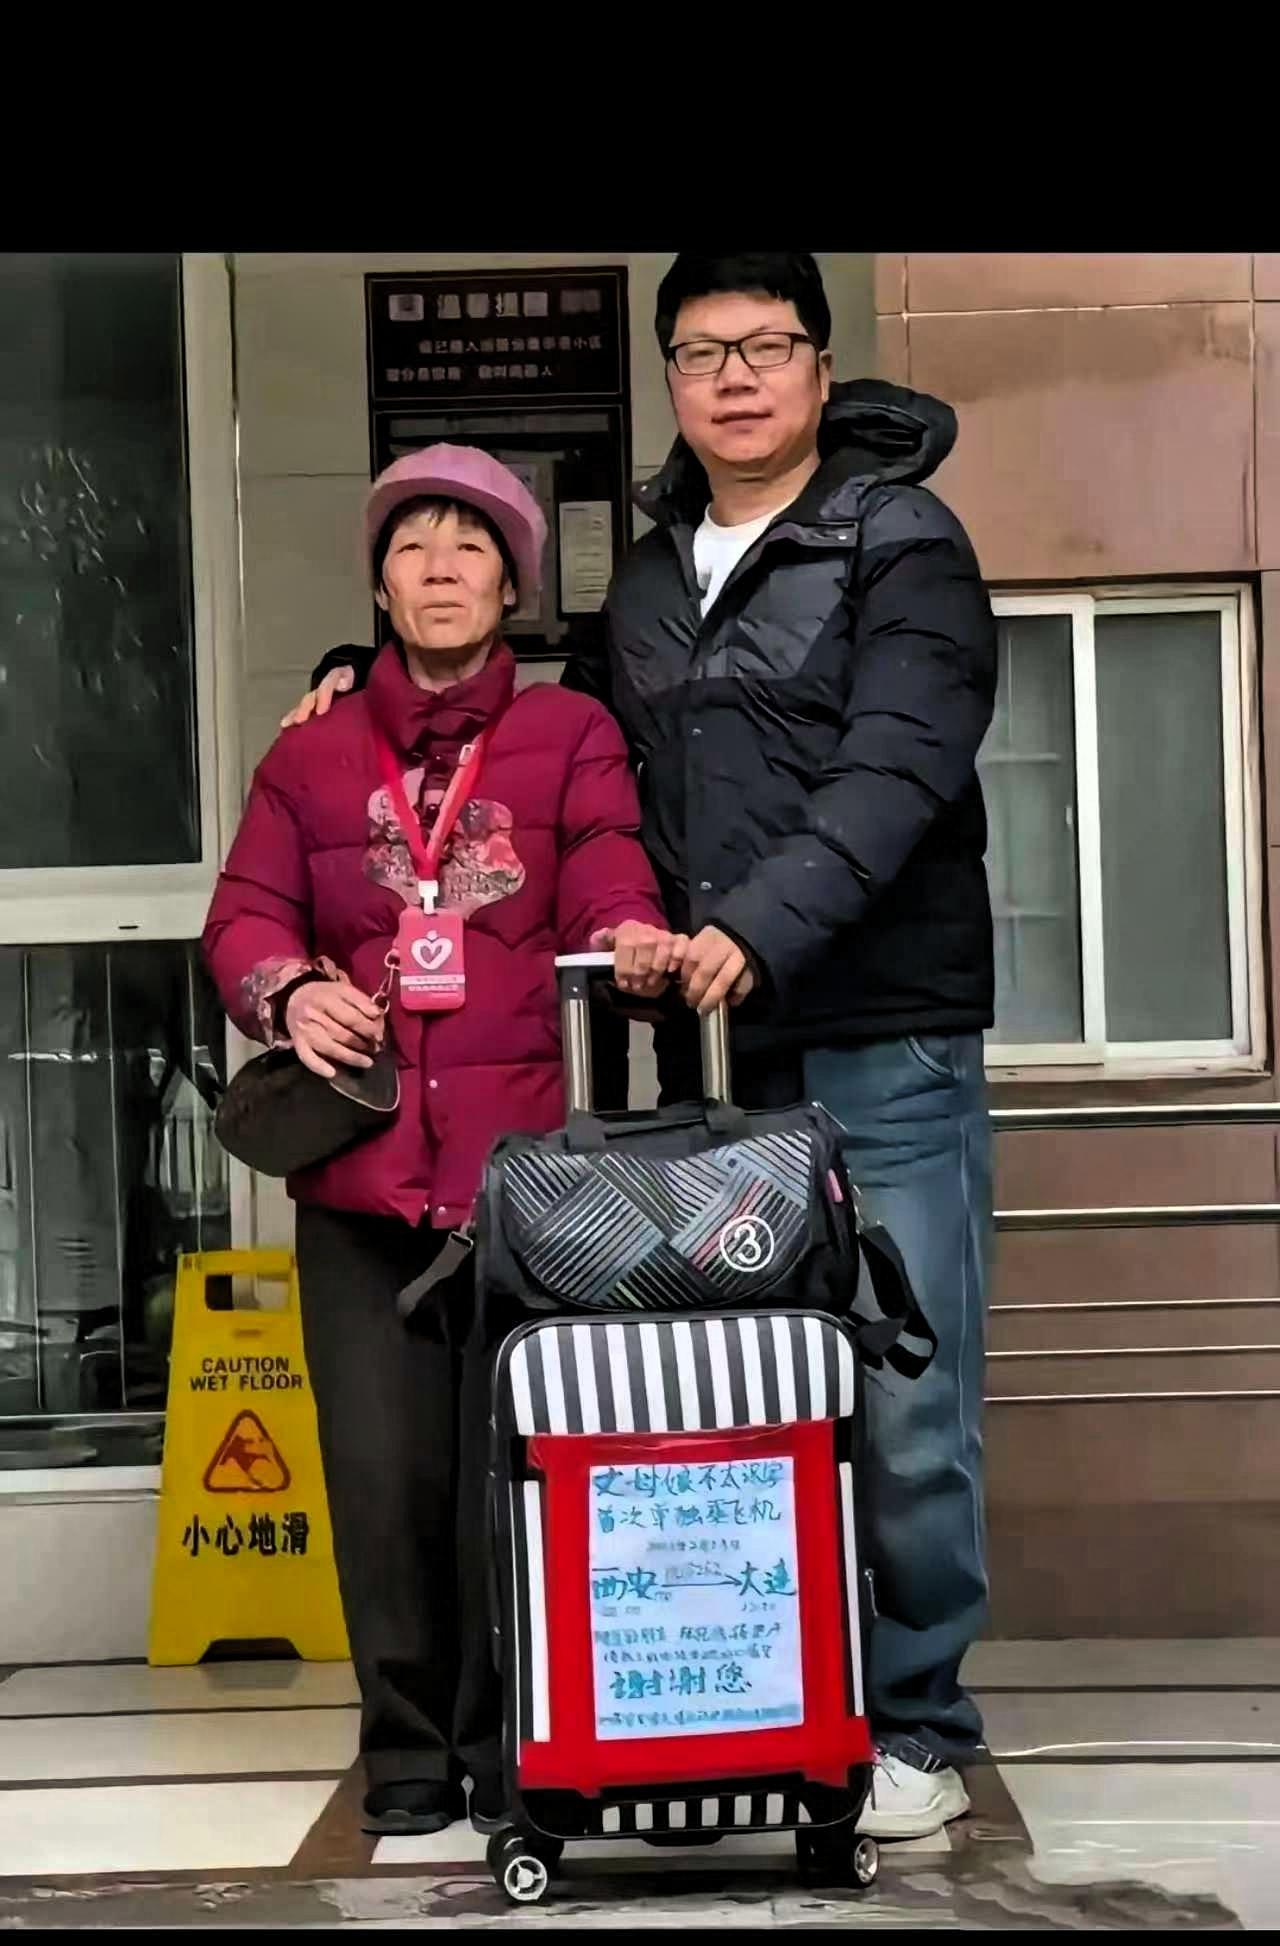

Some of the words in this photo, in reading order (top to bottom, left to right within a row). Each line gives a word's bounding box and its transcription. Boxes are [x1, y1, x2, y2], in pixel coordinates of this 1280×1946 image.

[202, 1356, 289, 1374] CAUTION
[190, 1375, 229, 1391] WET
[239, 1373, 303, 1391] FLOOR
[182, 1511, 309, 1557] 小心地滑
[609, 1660, 753, 1700] 谢谢您
